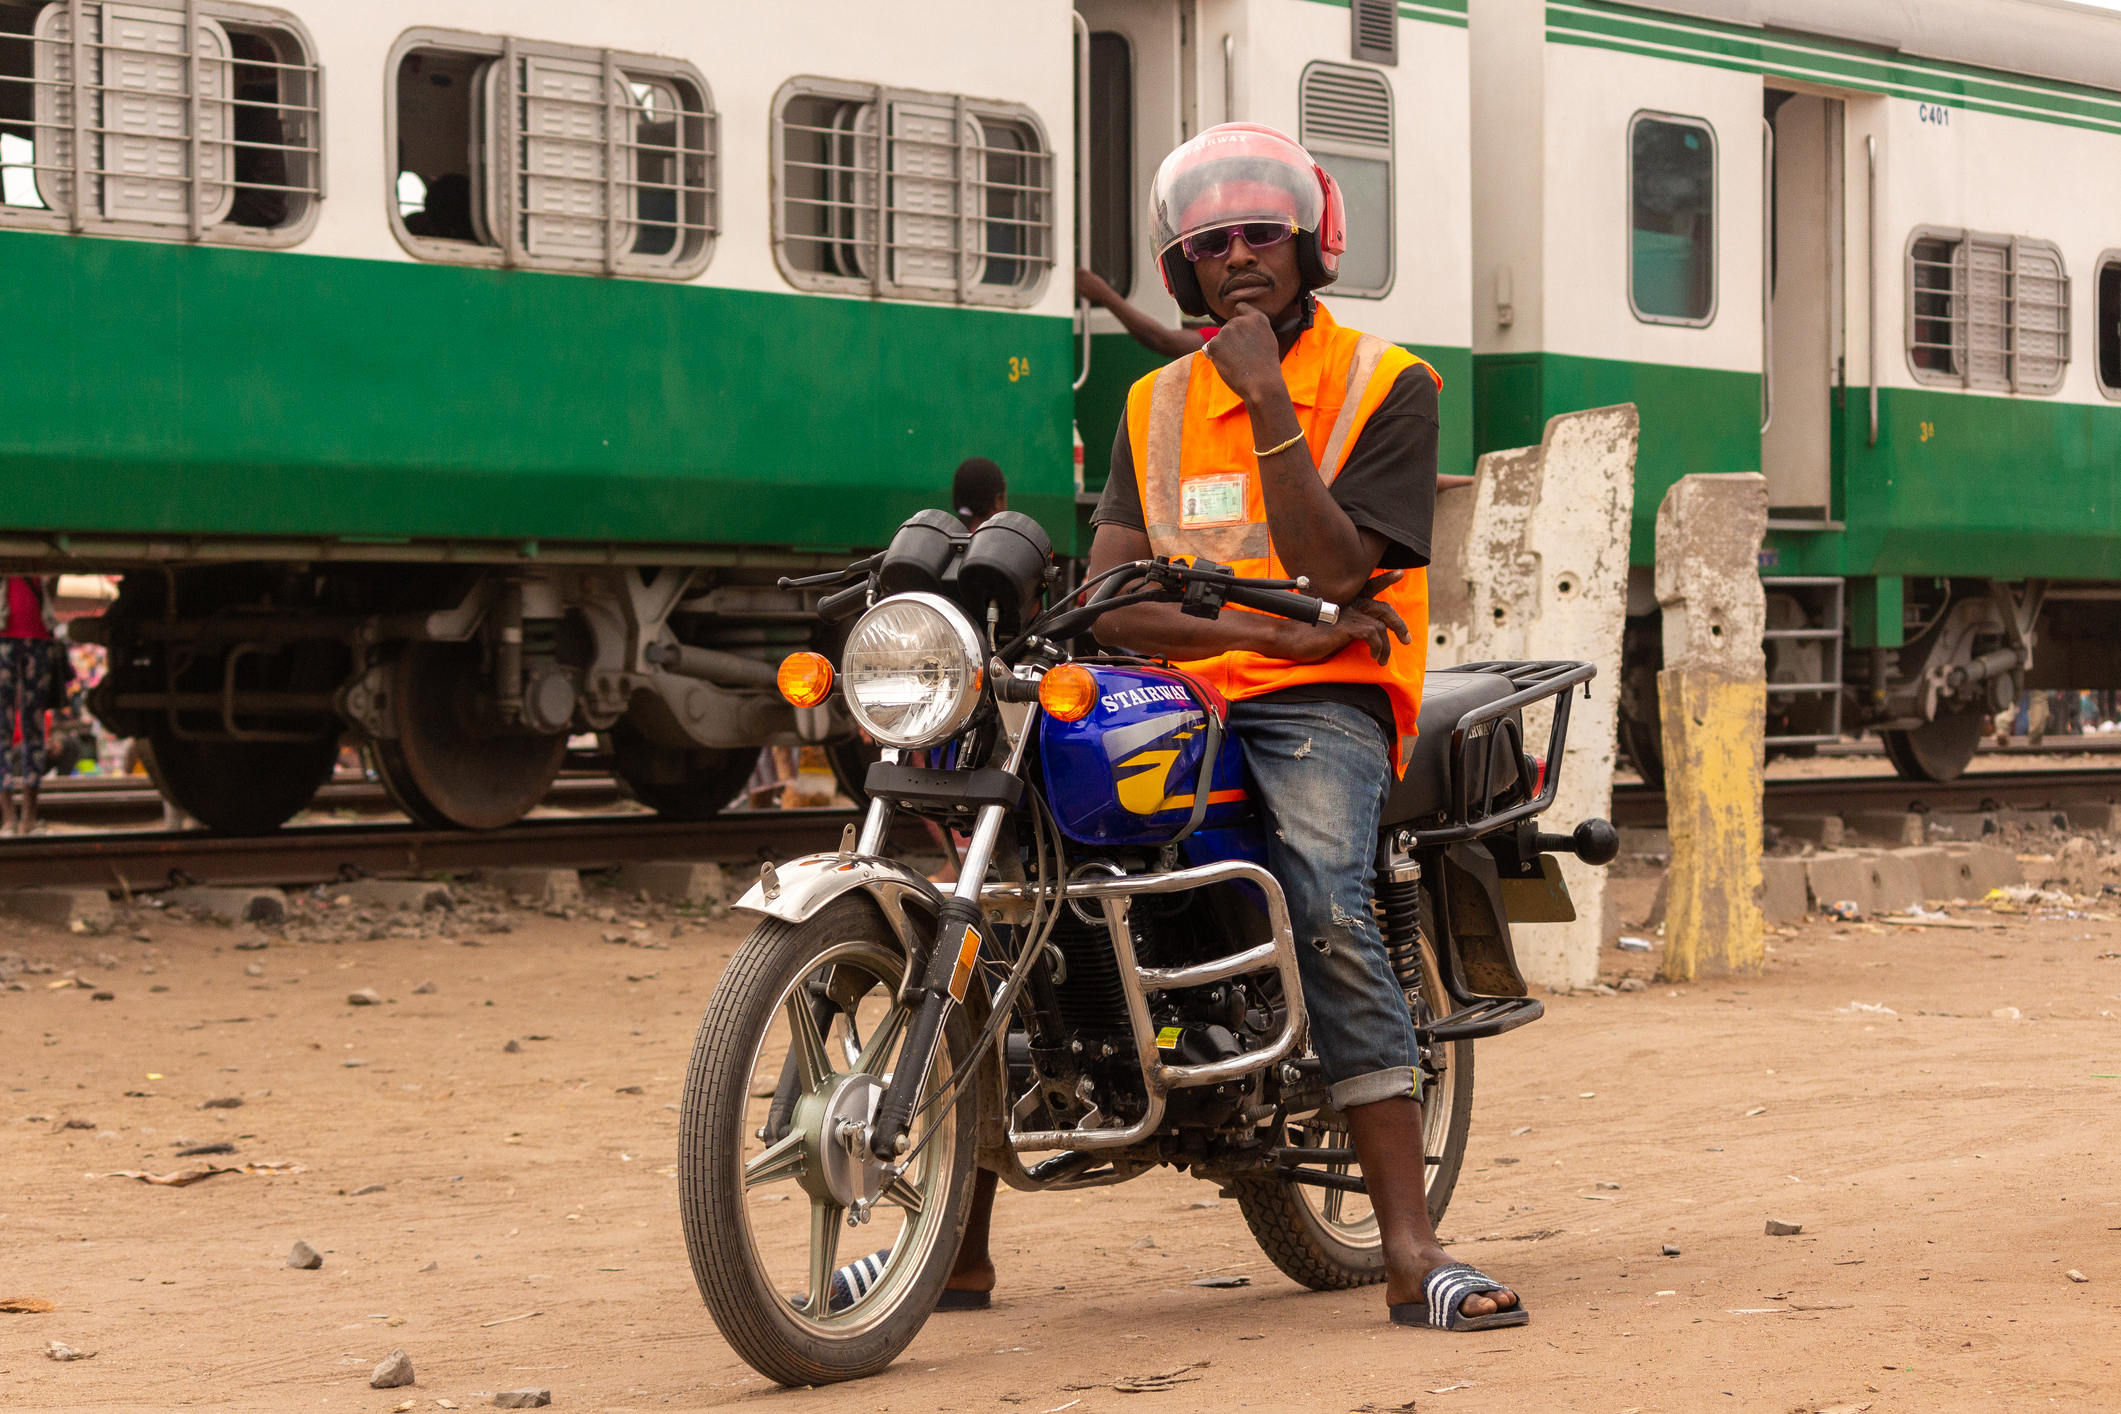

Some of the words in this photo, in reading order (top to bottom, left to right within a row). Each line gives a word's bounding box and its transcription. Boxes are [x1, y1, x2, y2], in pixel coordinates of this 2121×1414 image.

[1919, 102, 1949, 126] C401
[1181, 135, 1247, 158] TAIRWAY
[1101, 685, 1190, 713] STAIRWAY
